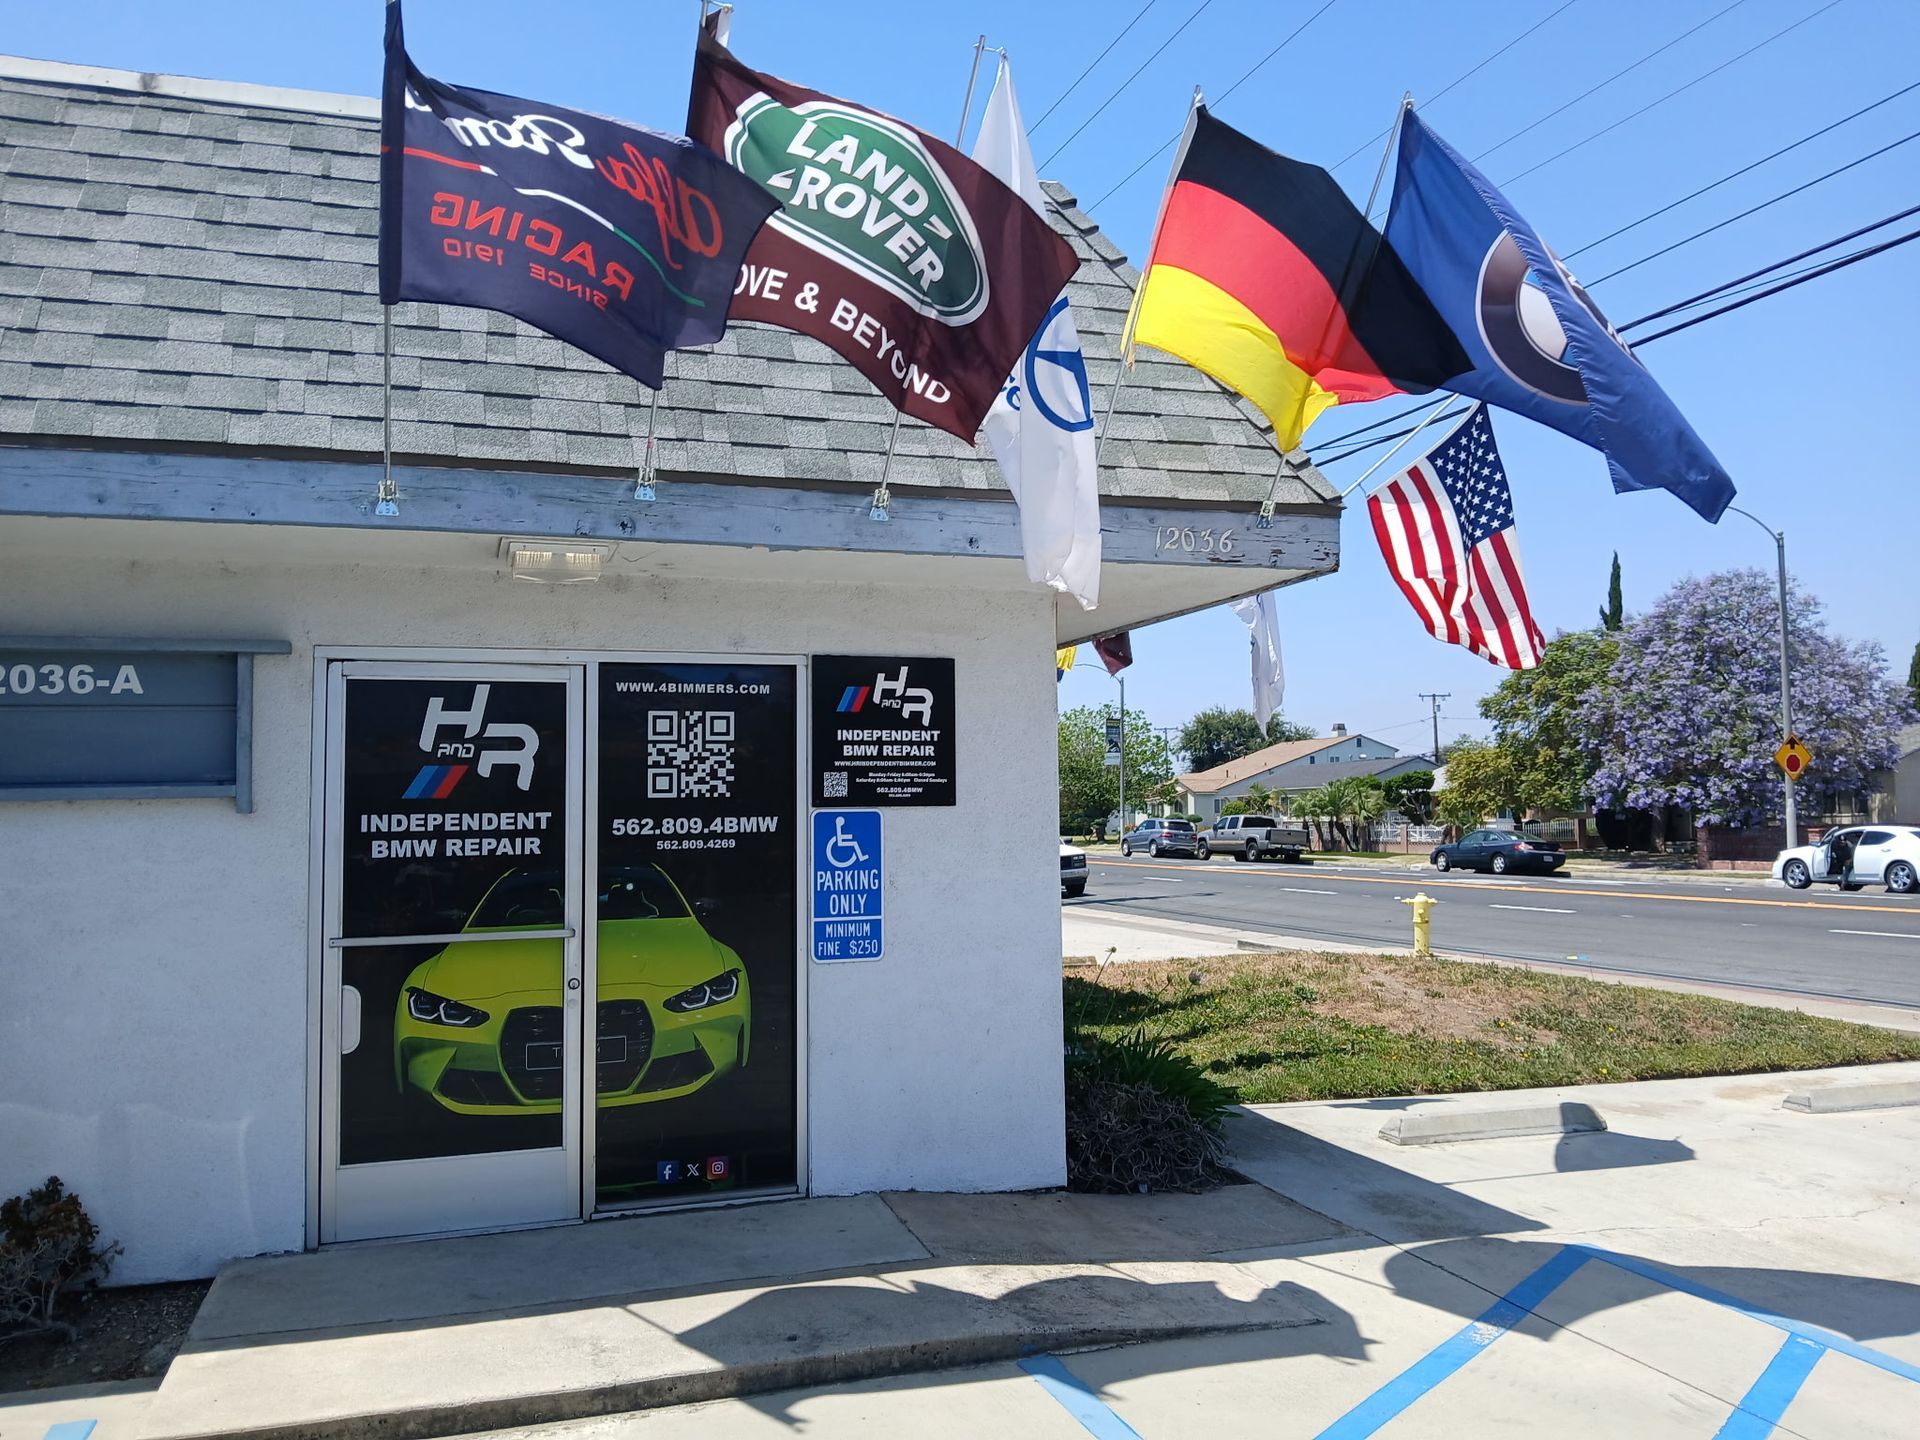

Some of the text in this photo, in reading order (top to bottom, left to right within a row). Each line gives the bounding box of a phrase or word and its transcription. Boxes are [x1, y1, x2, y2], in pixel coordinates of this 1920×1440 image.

[786, 118, 929, 219] LAND
[791, 164, 945, 293] ROVER
[795, 281, 821, 314] &
[830, 297, 951, 404] BEYOND
[1155, 526, 1234, 553] 12036
[0, 663, 144, 695] 036-A
[616, 681, 771, 695] WWW.4BIMMERS.COM
[837, 729, 941, 742] INDEPENDENT
[843, 744, 935, 757] BMW REPAIR
[360, 811, 553, 833] INDEPENDENT
[612, 815, 779, 836] 562.809.4BMW
[371, 836, 541, 859] BMW REPAIR
[656, 839, 736, 851] 562.809.4269
[816, 869, 880, 891] PARKING
[829, 893, 868, 916] ONLY
[825, 922, 871, 938] MINIMUM
[818, 939, 879, 956] FINE $250
